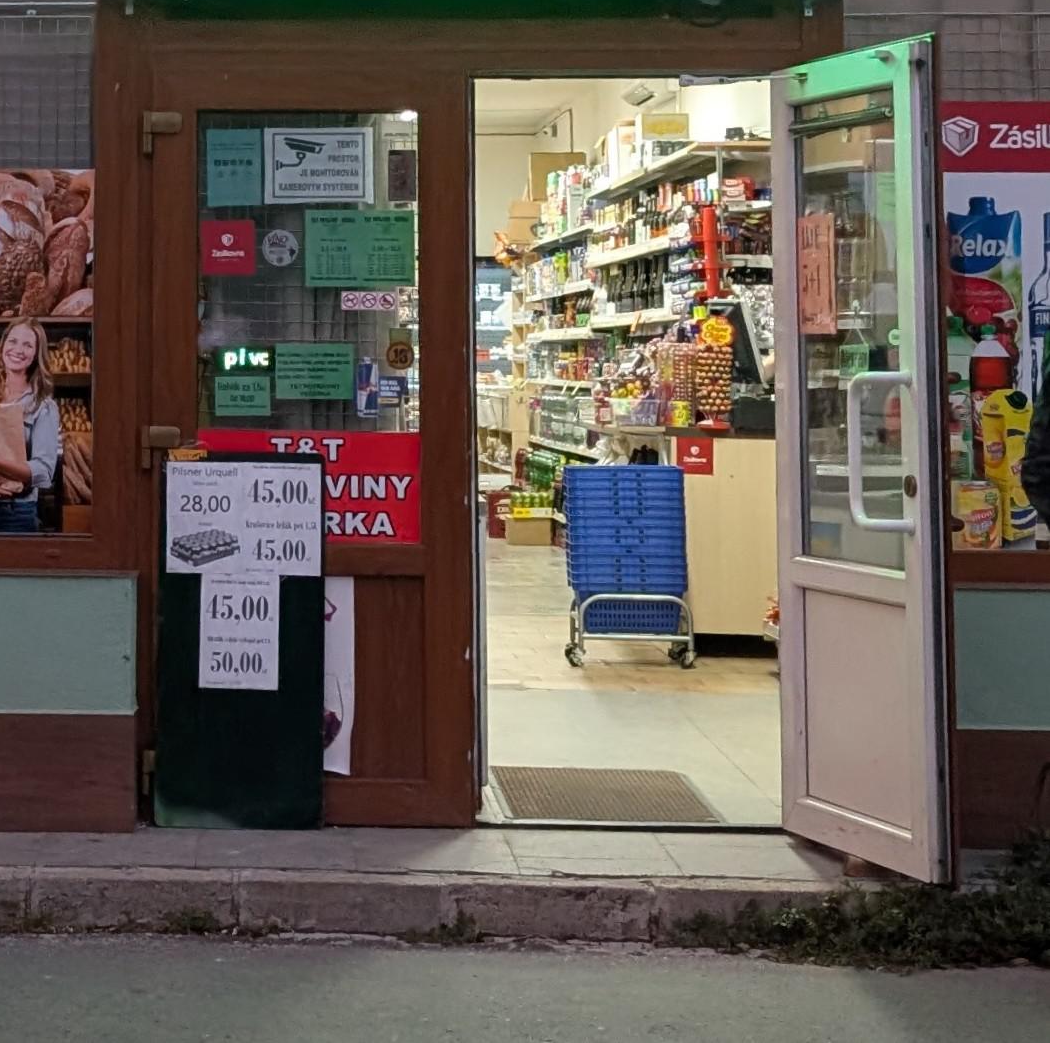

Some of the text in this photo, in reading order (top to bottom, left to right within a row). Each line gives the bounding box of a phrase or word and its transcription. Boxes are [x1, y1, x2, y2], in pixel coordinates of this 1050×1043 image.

[172, 467, 238, 478] Pilsner Urquell
[180, 495, 231, 515] 28,00
[247, 479, 308, 507] 45,00
[253, 538, 306, 564] 45,00
[206, 594, 269, 626] 45,00
[210, 651, 262, 677] 50,00
